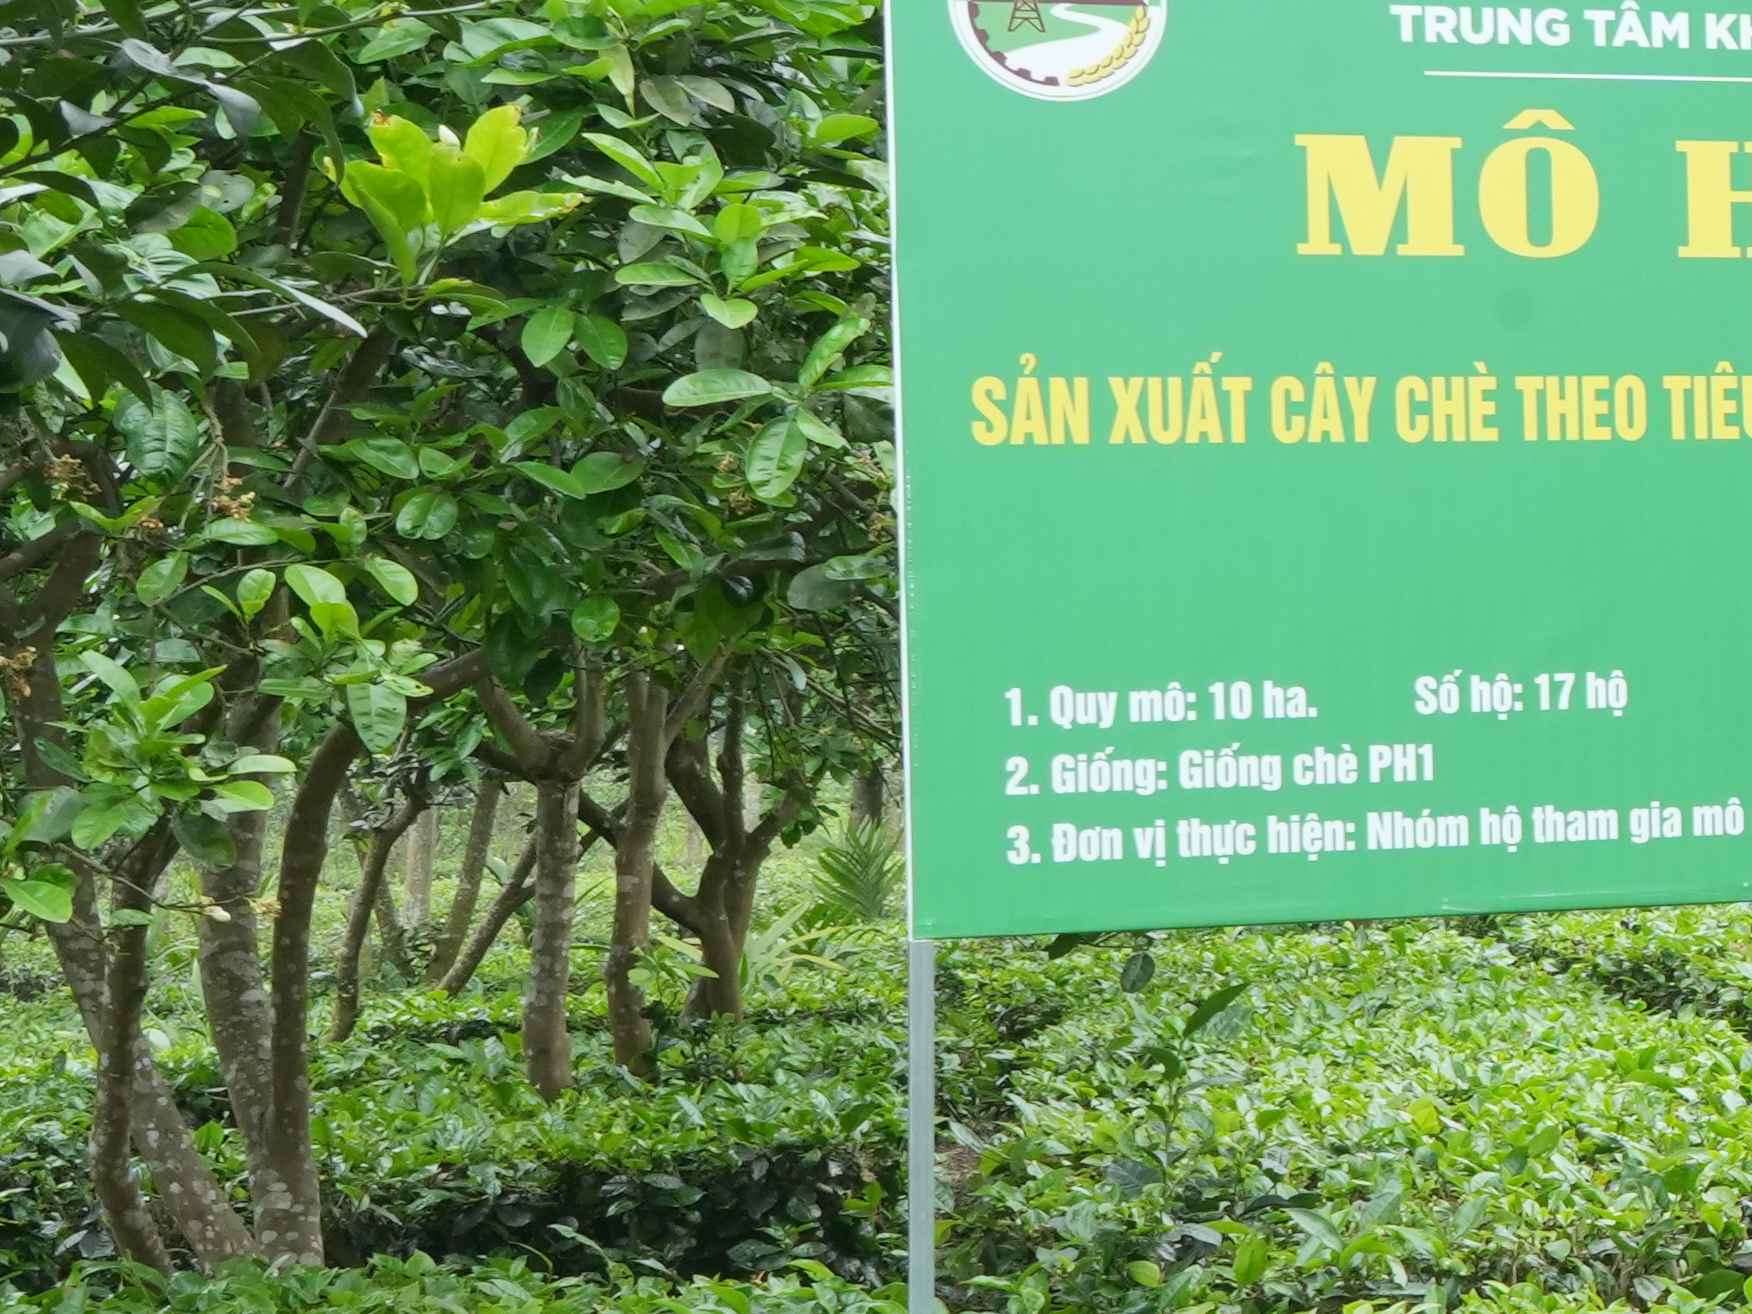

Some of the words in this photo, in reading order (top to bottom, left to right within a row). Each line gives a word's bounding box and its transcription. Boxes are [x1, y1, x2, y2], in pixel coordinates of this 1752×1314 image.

[1390, 5, 1570, 46] TRUNG
[1584, 0, 1690, 48] TÂM
[1295, 109, 1600, 258] MÔ
[972, 353, 1090, 446] SẢN
[1108, 352, 1253, 445] XUẤT
[1271, 362, 1376, 443] CÂY
[1396, 362, 1499, 443] CHÈ
[1515, 375, 1647, 441] THEO
[1005, 688, 1038, 726] 1.
[1050, 685, 1117, 729] Quy
[1130, 682, 1196, 722] mô:
[1209, 681, 1252, 719] 10
[1263, 681, 1317, 718] ha.
[1415, 670, 1462, 714] Số
[1471, 673, 1523, 720] hộ:
[1535, 673, 1575, 710] 17
[1587, 670, 1627, 716] hộ
[1006, 756, 1039, 795] 2.
[1052, 747, 1167, 795] Giống:
[1179, 743, 1282, 791] Giống
[1293, 744, 1357, 785] chè
[1369, 744, 1433, 782] PH1
[1007, 825, 1041, 864] 3.
[1052, 823, 1123, 862] Đơn
[1134, 820, 1166, 866] vị
[1177, 818, 1256, 864] thực
[1268, 813, 1355, 860] hiện:
[1367, 809, 1469, 849] Nhóm
[1480, 805, 1522, 852] hộ
[1532, 805, 1618, 843] tham
[1630, 801, 1682, 843] gia
[1693, 797, 1744, 836] mô
